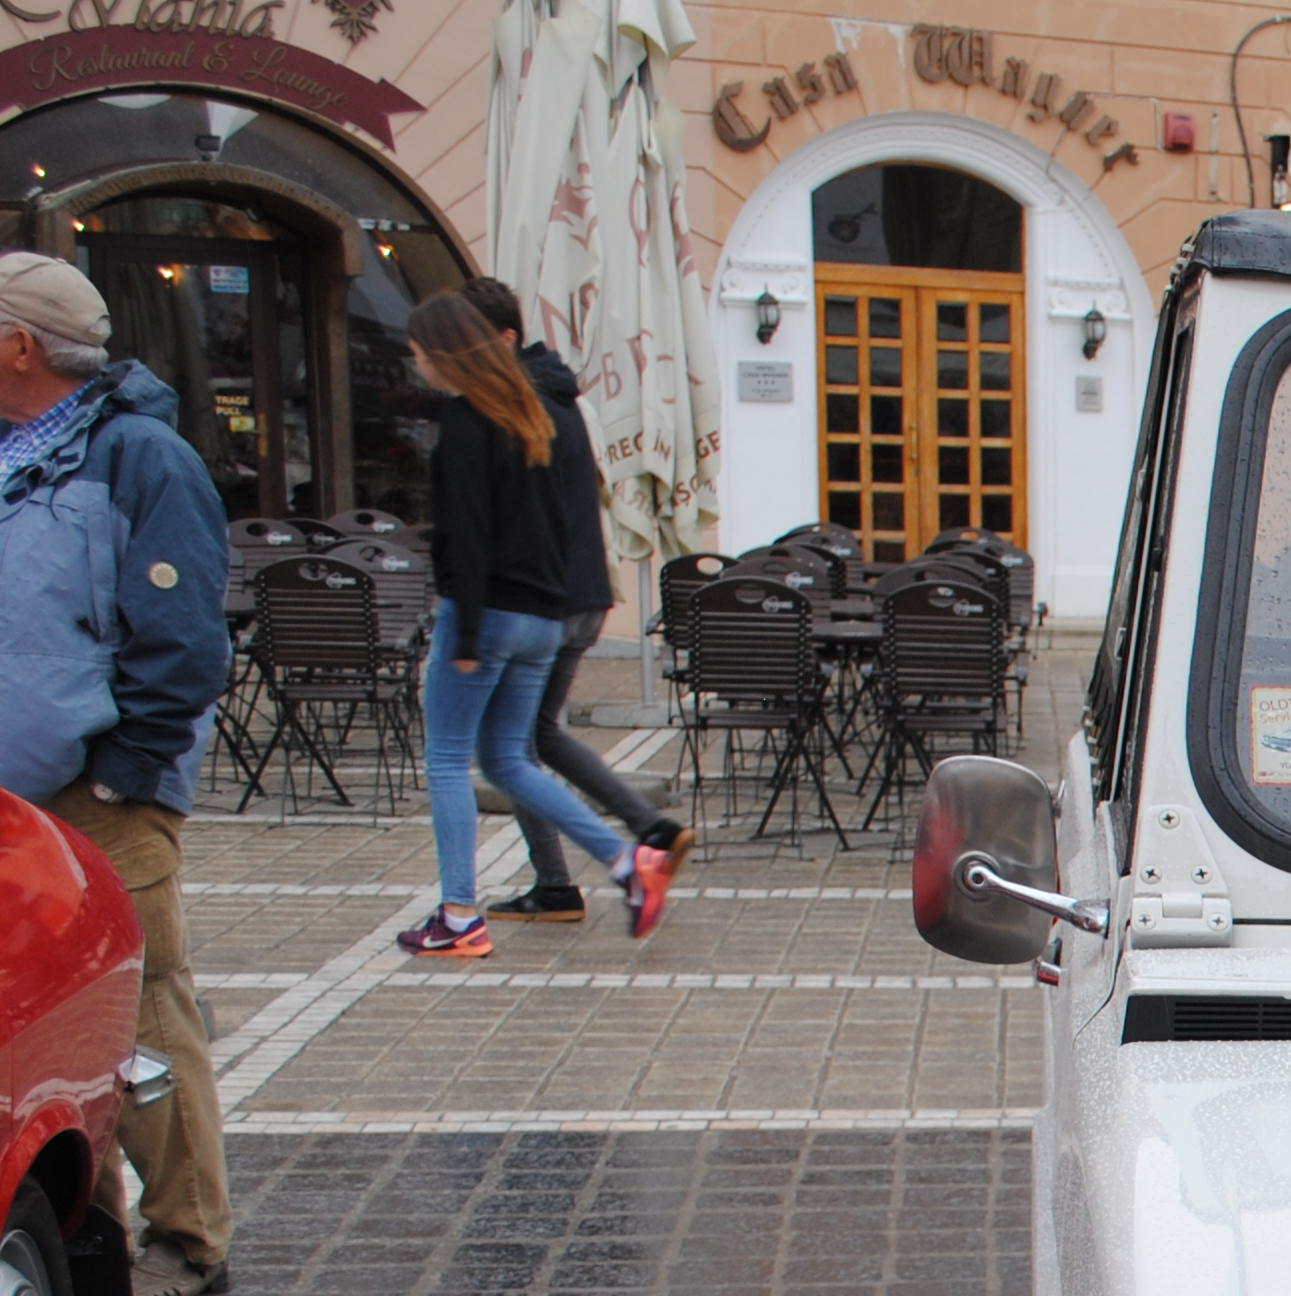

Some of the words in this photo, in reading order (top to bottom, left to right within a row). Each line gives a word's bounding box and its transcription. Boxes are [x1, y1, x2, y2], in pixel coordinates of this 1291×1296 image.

[29, 42, 193, 91] Restaurant
[241, 45, 346, 106] Lounge
[712, 51, 858, 152] Casa
[912, 23, 1140, 172] Wagner
